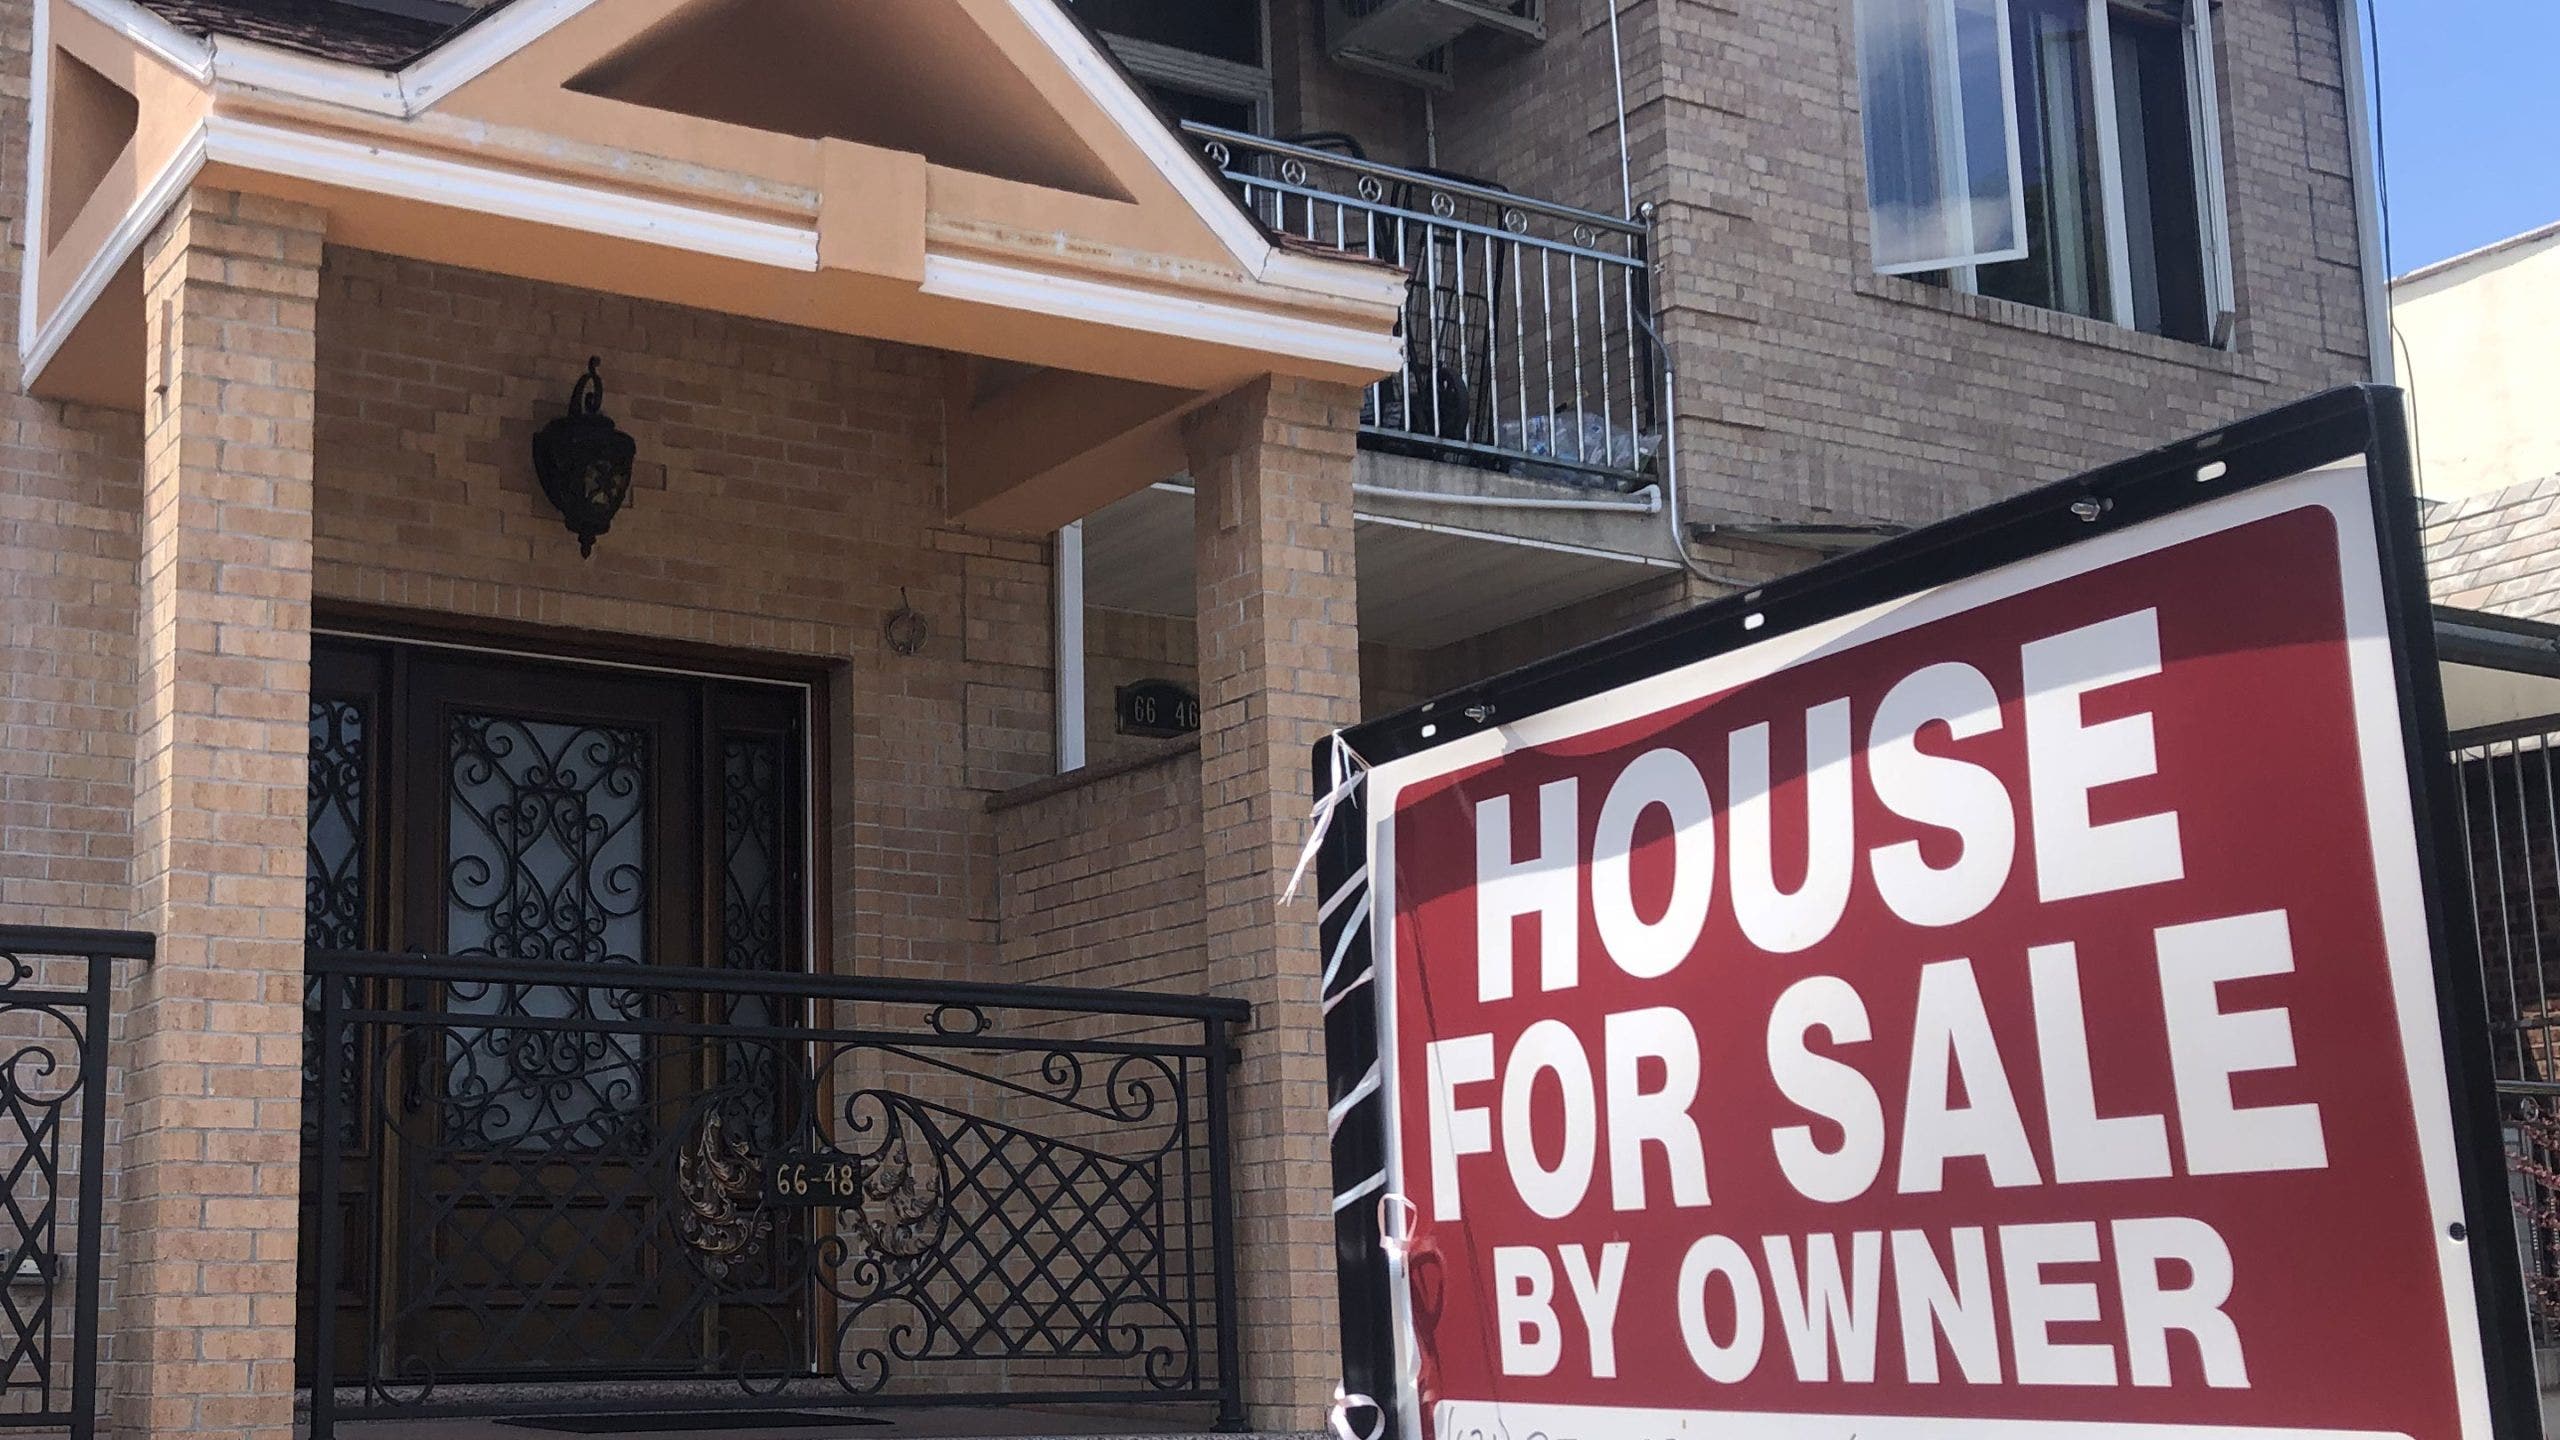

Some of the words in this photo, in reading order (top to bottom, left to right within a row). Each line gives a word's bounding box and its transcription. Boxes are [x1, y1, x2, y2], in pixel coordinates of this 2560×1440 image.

[1134, 696, 1156, 723] 66
[1175, 701, 1198, 728] 46
[1475, 606, 2185, 1003] HOUSE
[1426, 1005, 1712, 1222] FOR
[1766, 908, 2329, 1204] SALE
[777, 1163, 854, 1196] 66-48
[1493, 1241, 1631, 1379] BY
[1677, 1216, 2252, 1389] OWNER
